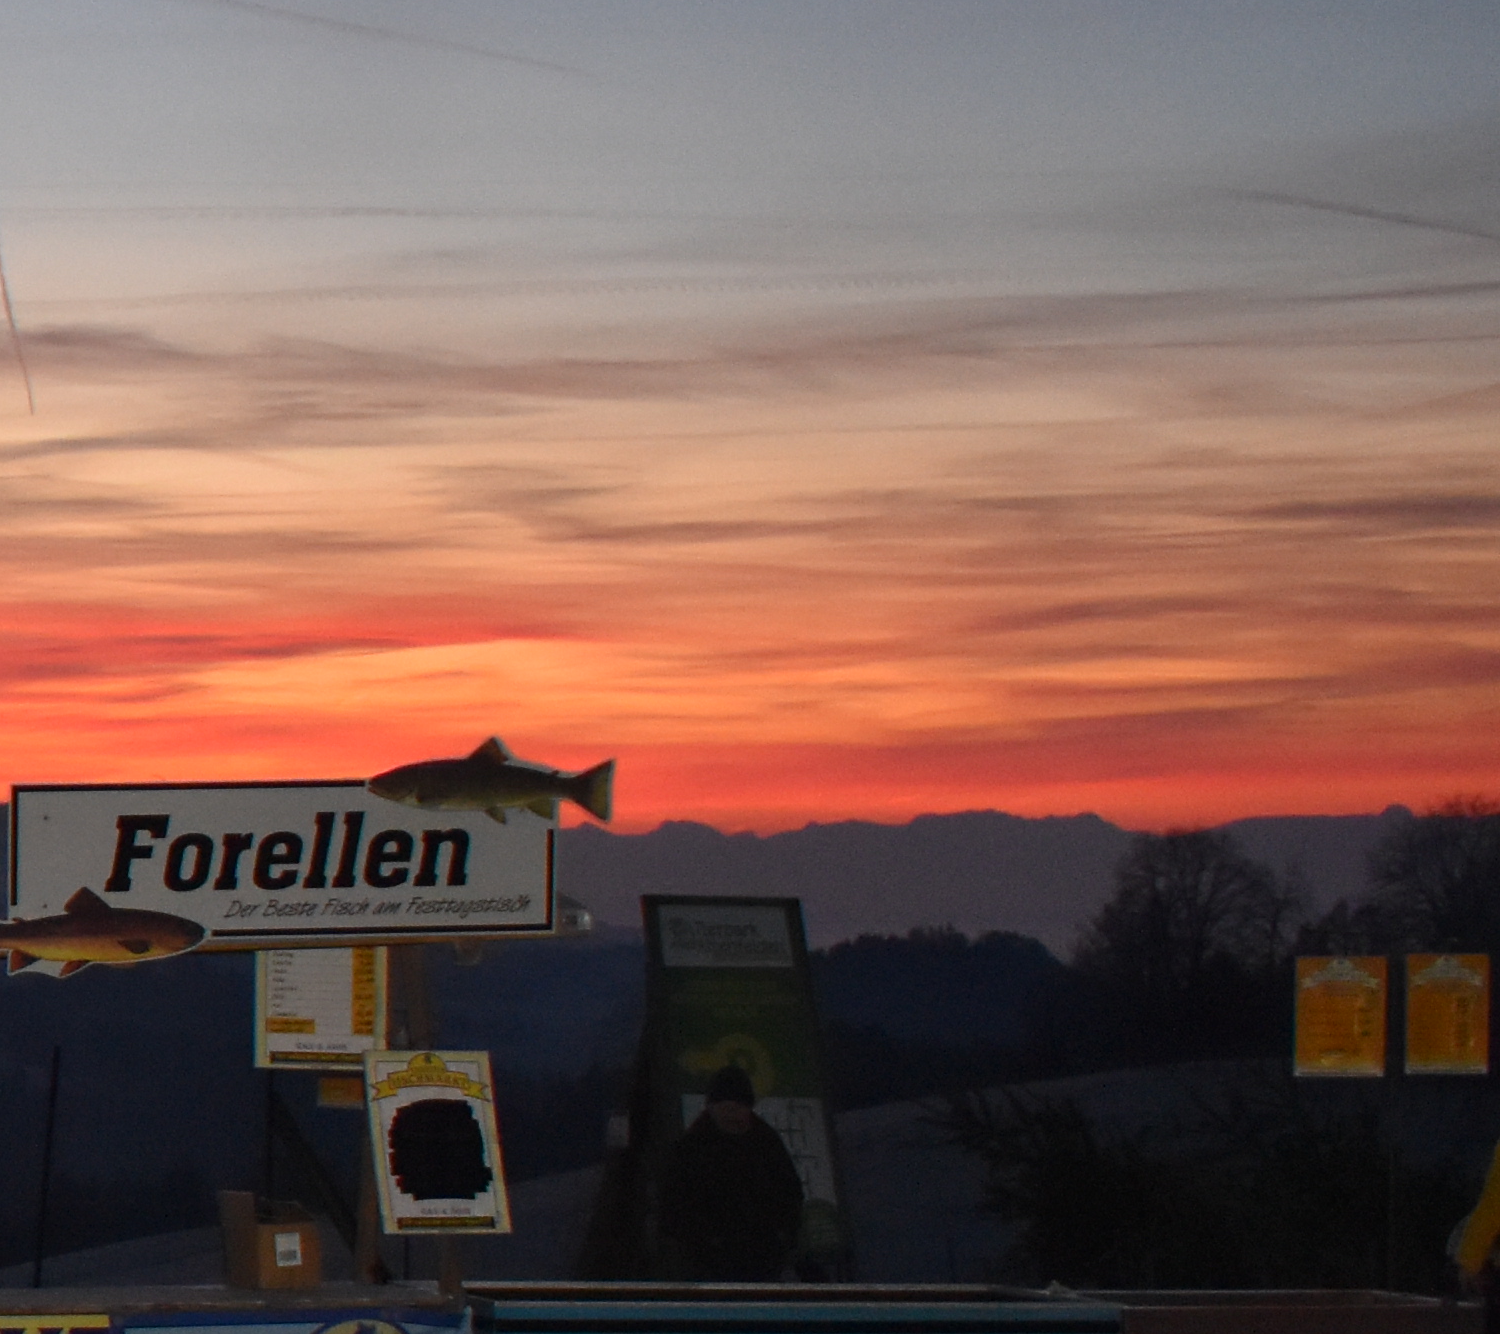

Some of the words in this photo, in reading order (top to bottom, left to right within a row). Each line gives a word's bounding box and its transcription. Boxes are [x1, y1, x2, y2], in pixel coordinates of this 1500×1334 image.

[104, 810, 471, 892] Forellen
[223, 899, 255, 919] Der
[262, 898, 318, 918] Beste
[320, 897, 368, 916] Fisch
[372, 901, 402, 916] am
